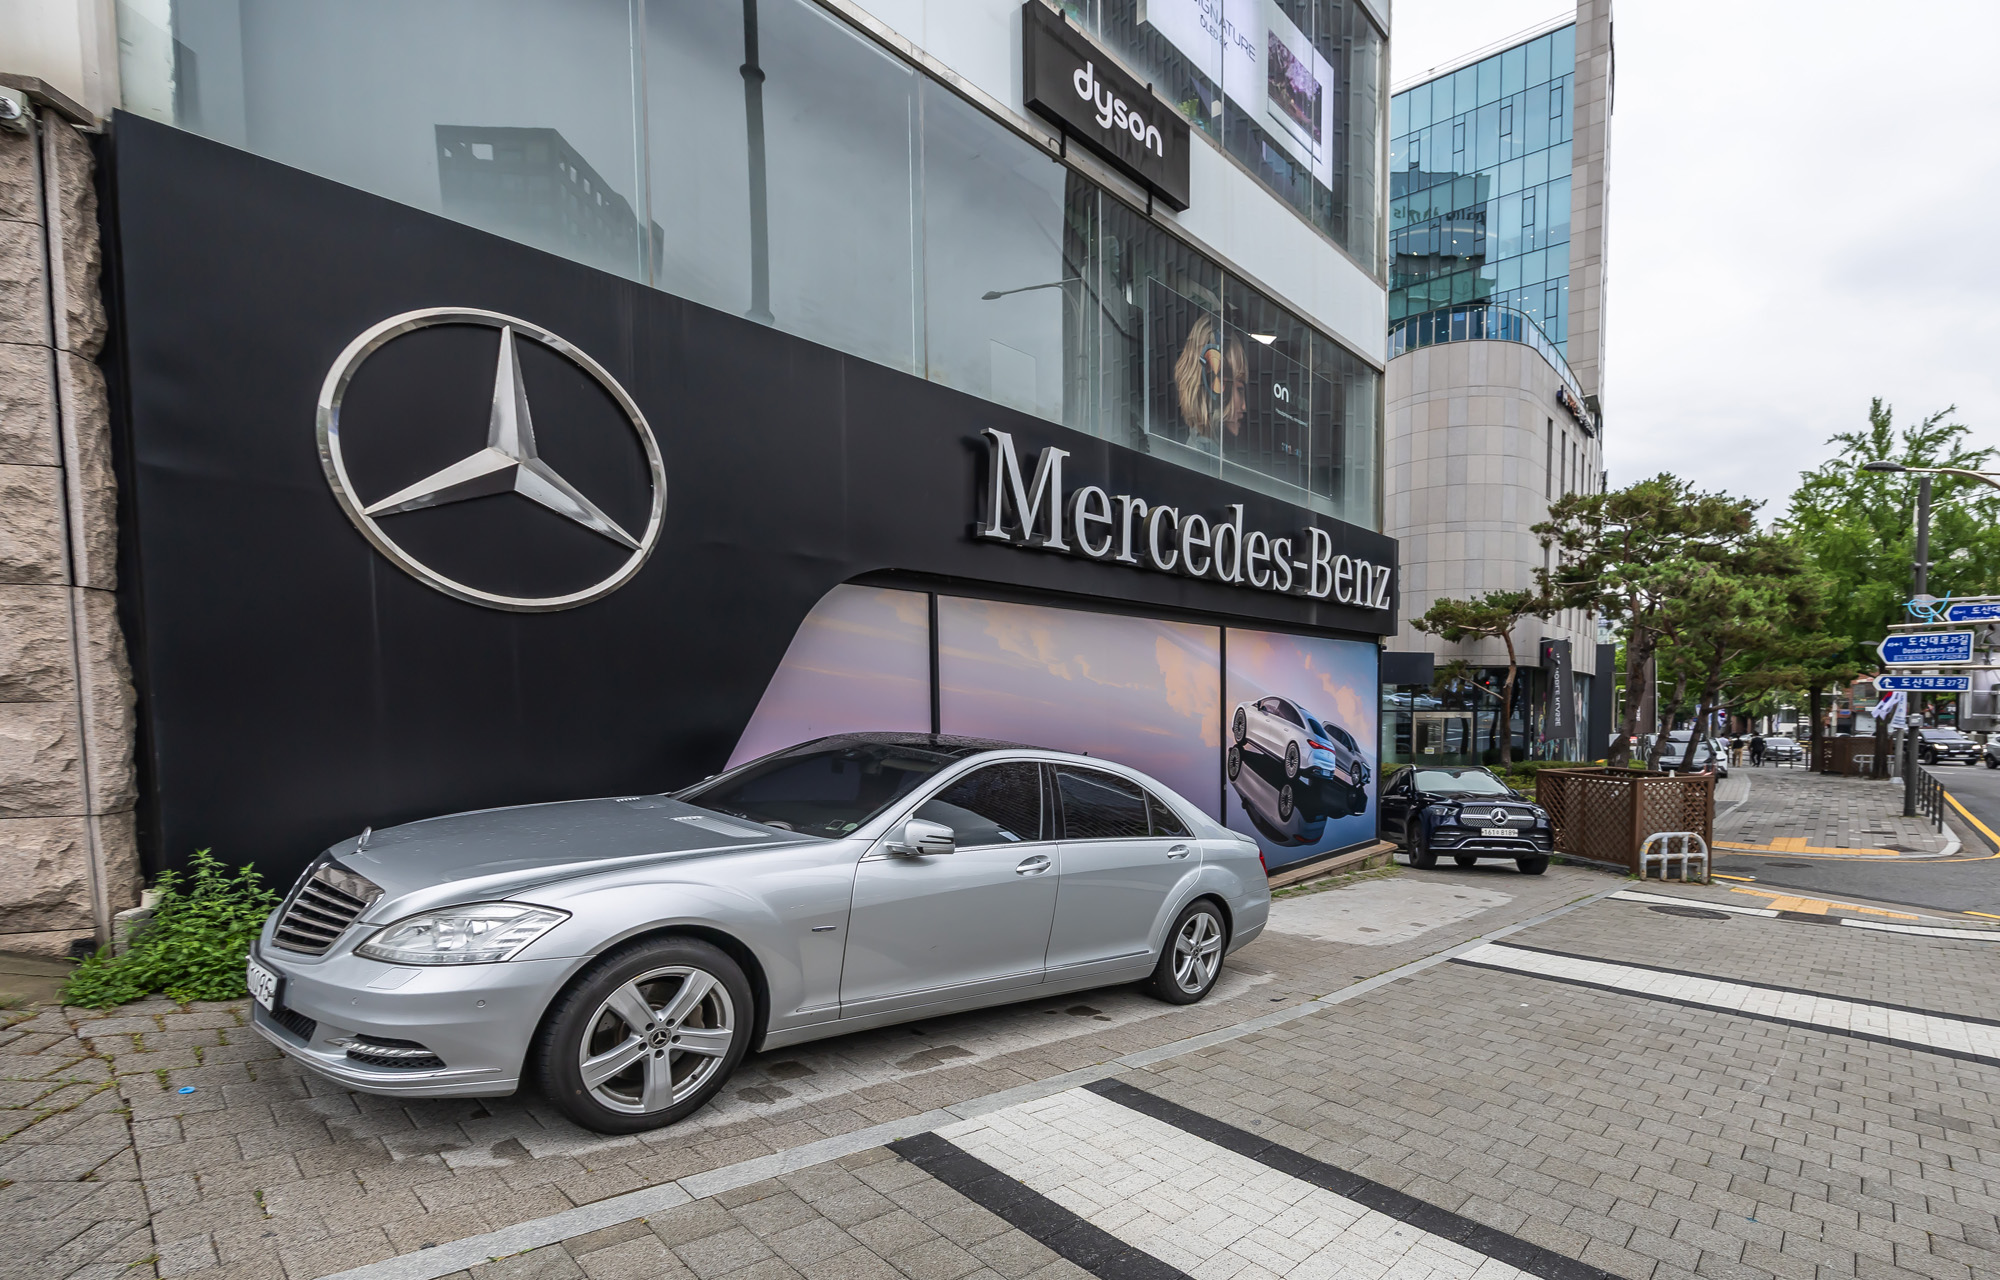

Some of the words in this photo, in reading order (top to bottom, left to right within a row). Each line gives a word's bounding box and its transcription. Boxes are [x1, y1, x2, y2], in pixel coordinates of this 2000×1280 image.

[1194, 0, 1256, 63] GNATURE
[1073, 60, 1163, 158] dyson
[978, 427, 1391, 611] Mercedes-Benz
[1901, 678, 1967, 688] 도산대로27길
